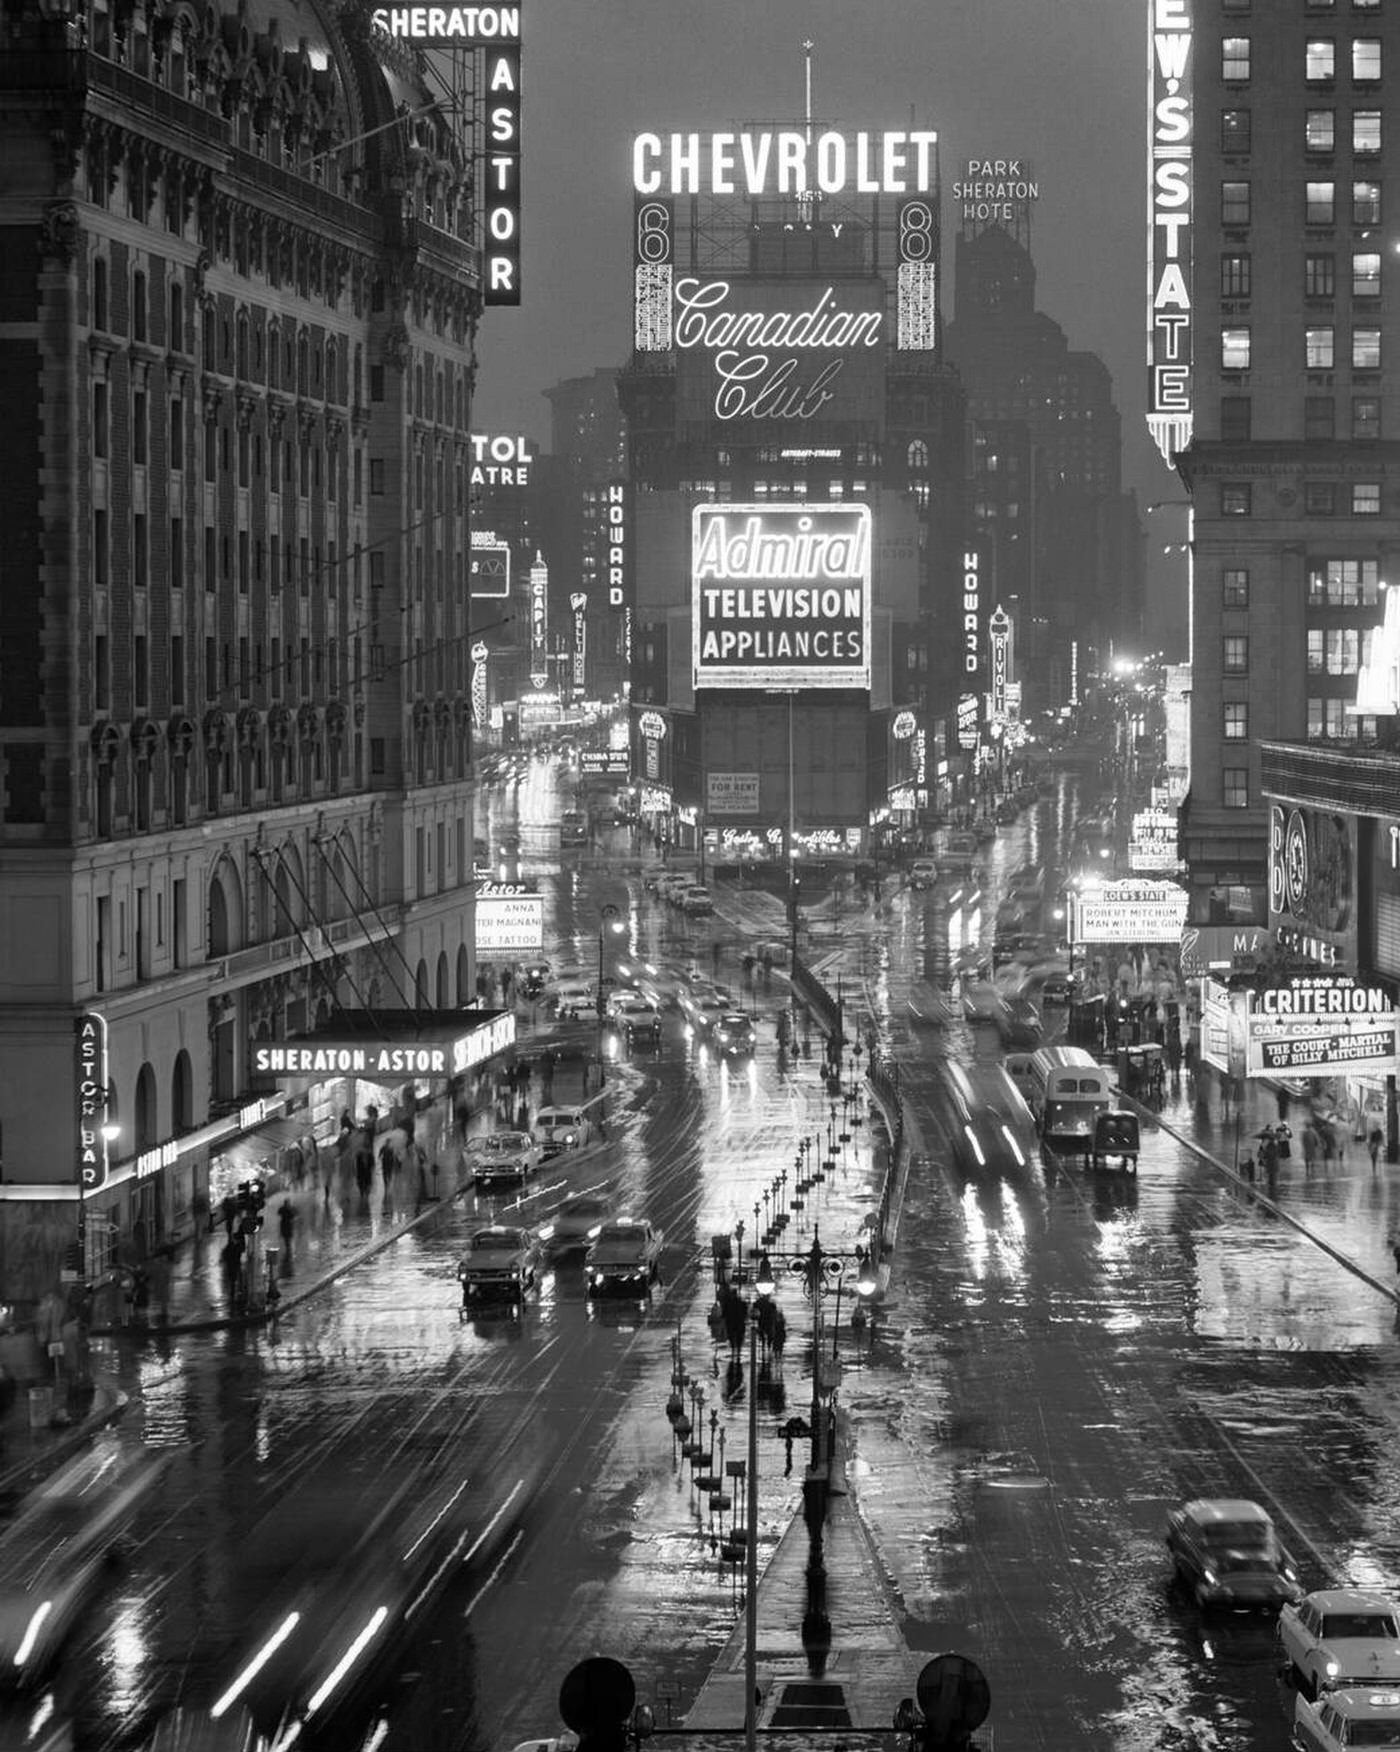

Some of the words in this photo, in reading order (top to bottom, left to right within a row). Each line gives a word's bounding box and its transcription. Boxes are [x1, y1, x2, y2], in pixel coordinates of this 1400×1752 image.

[372, 7, 519, 37] SHERATON
[490, 57, 515, 291] ASTOR
[633, 131, 938, 194] CHEVROLET
[968, 160, 1021, 176] PARK
[952, 182, 1039, 199] SHERATON
[638, 203, 670, 264] 6
[900, 201, 932, 263] 8
[1154, 161, 1191, 411] STATE
[675, 278, 882, 348] Canadian
[714, 350, 843, 420] Club
[470, 434, 532, 463] TOL
[470, 466, 528, 486] ATRE
[609, 486, 624, 605] HOWARD
[696, 516, 871, 578] Admiral
[704, 588, 861, 618] TELEVISION
[963, 553, 979, 672] HOWARD
[702, 631, 861, 659] APPLIANCES
[996, 637, 1005, 709] RIVOLI
[711, 783, 730, 791] FOR
[734, 783, 757, 791] RENT
[475, 880, 526, 896] Astor
[496, 918, 543, 927] MAGNANI
[504, 904, 535, 913] ANNA
[1086, 908, 1126, 917] ROBERT
[1129, 908, 1178, 917] MITCHUM
[1086, 919, 1109, 928] MAN
[1111, 919, 1137, 928] WITH
[1141, 919, 1158, 928] THE
[1160, 919, 1182, 928] GUN
[498, 935, 537, 945] TATTOO
[1263, 988, 1383, 1014] CRITERION
[1253, 1023, 1288, 1036] GARY
[1291, 1023, 1351, 1035] COOPER
[256, 1048, 366, 1071] SHERATON
[377, 1049, 445, 1072] ASTOR
[1266, 1043, 1290, 1055] THE
[1272, 1055, 1288, 1066] OF
[1291, 1050, 1324, 1064] BILLY
[1327, 1045, 1387, 1061] MITCHELL
[81, 1022, 98, 1115] ASTOR
[81, 1130, 97, 1184] BAR
